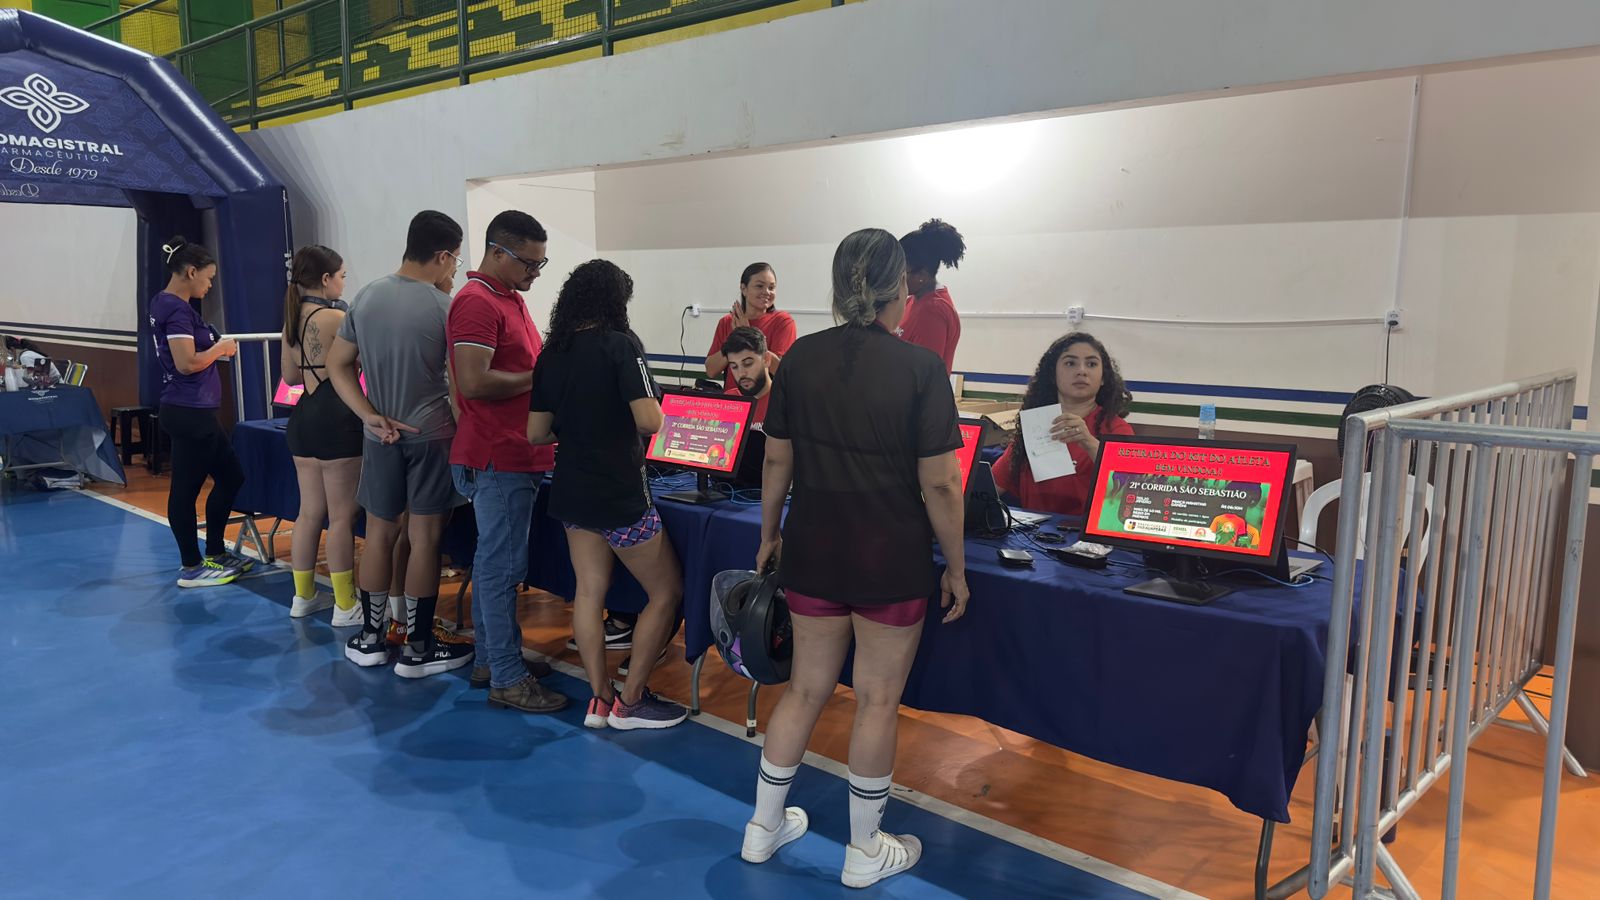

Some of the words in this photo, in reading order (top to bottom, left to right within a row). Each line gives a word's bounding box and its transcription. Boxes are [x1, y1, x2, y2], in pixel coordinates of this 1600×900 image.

[0, 133, 123, 155] OMAGISTRAL
[10, 157, 63, 175] Desde
[66, 167, 98, 180] 1979
[1118, 447, 1167, 459] RETIRADA
[1170, 451, 1186, 460] DO
[1188, 452, 1207, 462] KIT
[1209, 454, 1225, 464] DO
[1227, 456, 1270, 467] ATLETA
[1155, 463, 1174, 472] BEM
[1141, 483, 1178, 493] CORRIDA
[1179, 486, 1197, 495] SÃO
[1198, 487, 1247, 499] SEBASTIÃO
